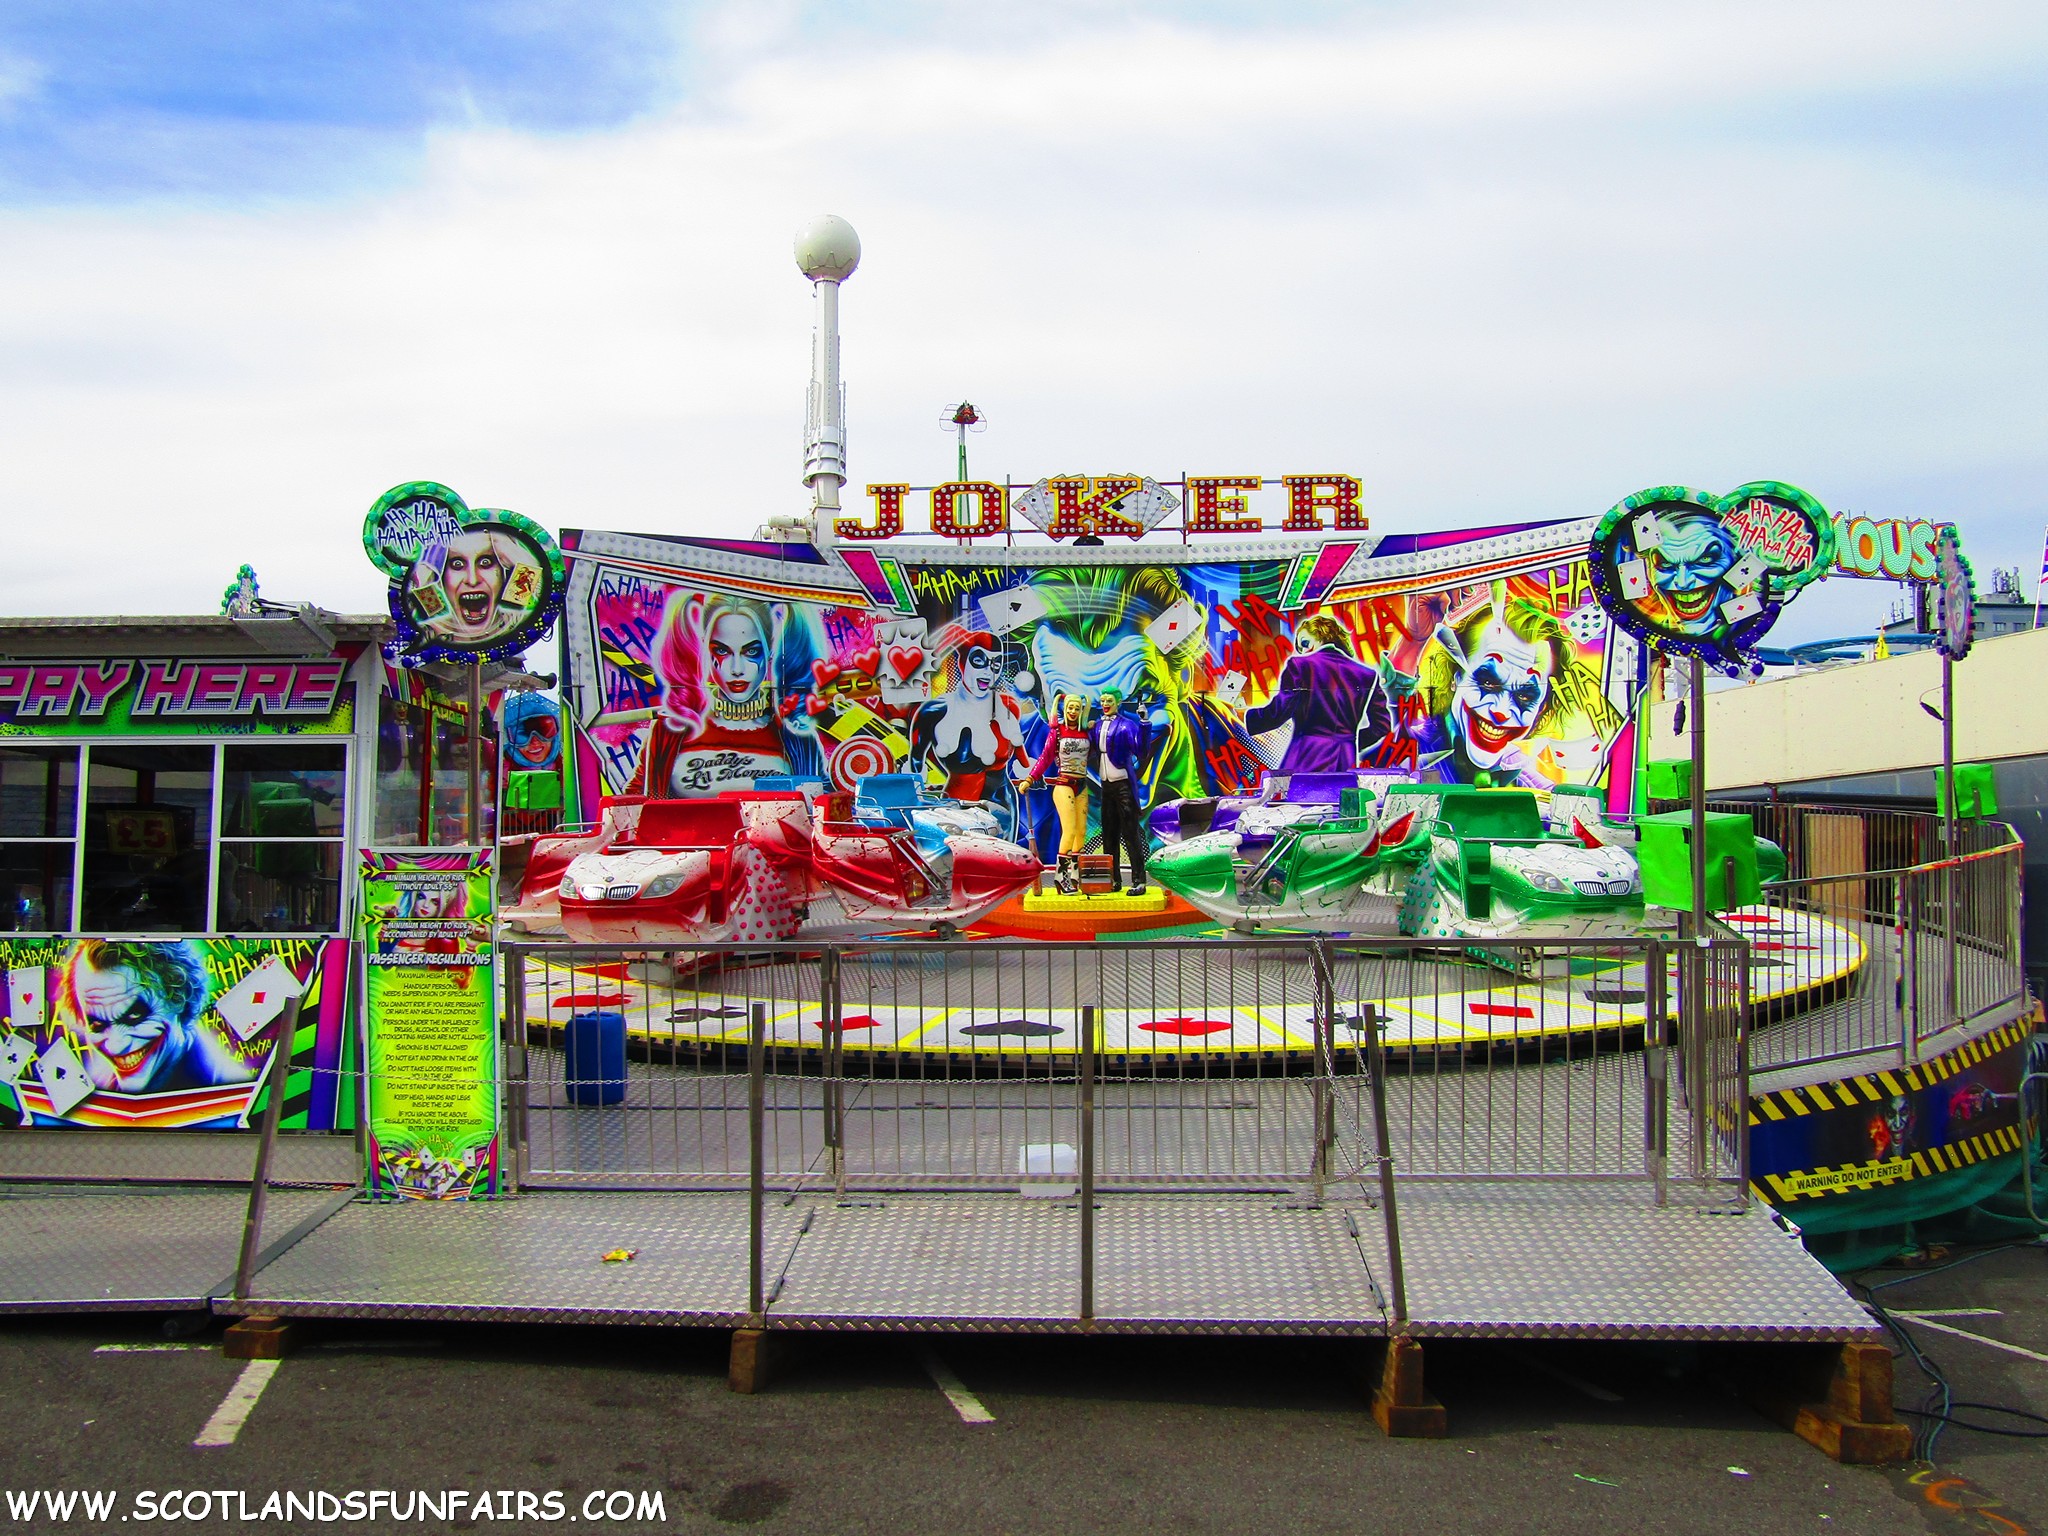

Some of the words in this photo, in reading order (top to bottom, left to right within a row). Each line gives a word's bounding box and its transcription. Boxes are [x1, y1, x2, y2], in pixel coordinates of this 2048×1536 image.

[834, 475, 1369, 540] JOKER
[1832, 512, 1957, 582] OUS
[131, 658, 348, 716] HERE
[714, 699, 766, 720] PUDDIN
[368, 953, 424, 965] PASSENGER
[425, 953, 491, 965] REGULATIONS
[1796, 1174, 1840, 1190] WARNING
[1842, 1172, 1854, 1182] DO
[1856, 1169, 1874, 1180] NOT
[1877, 1164, 1902, 1178] ENTER
